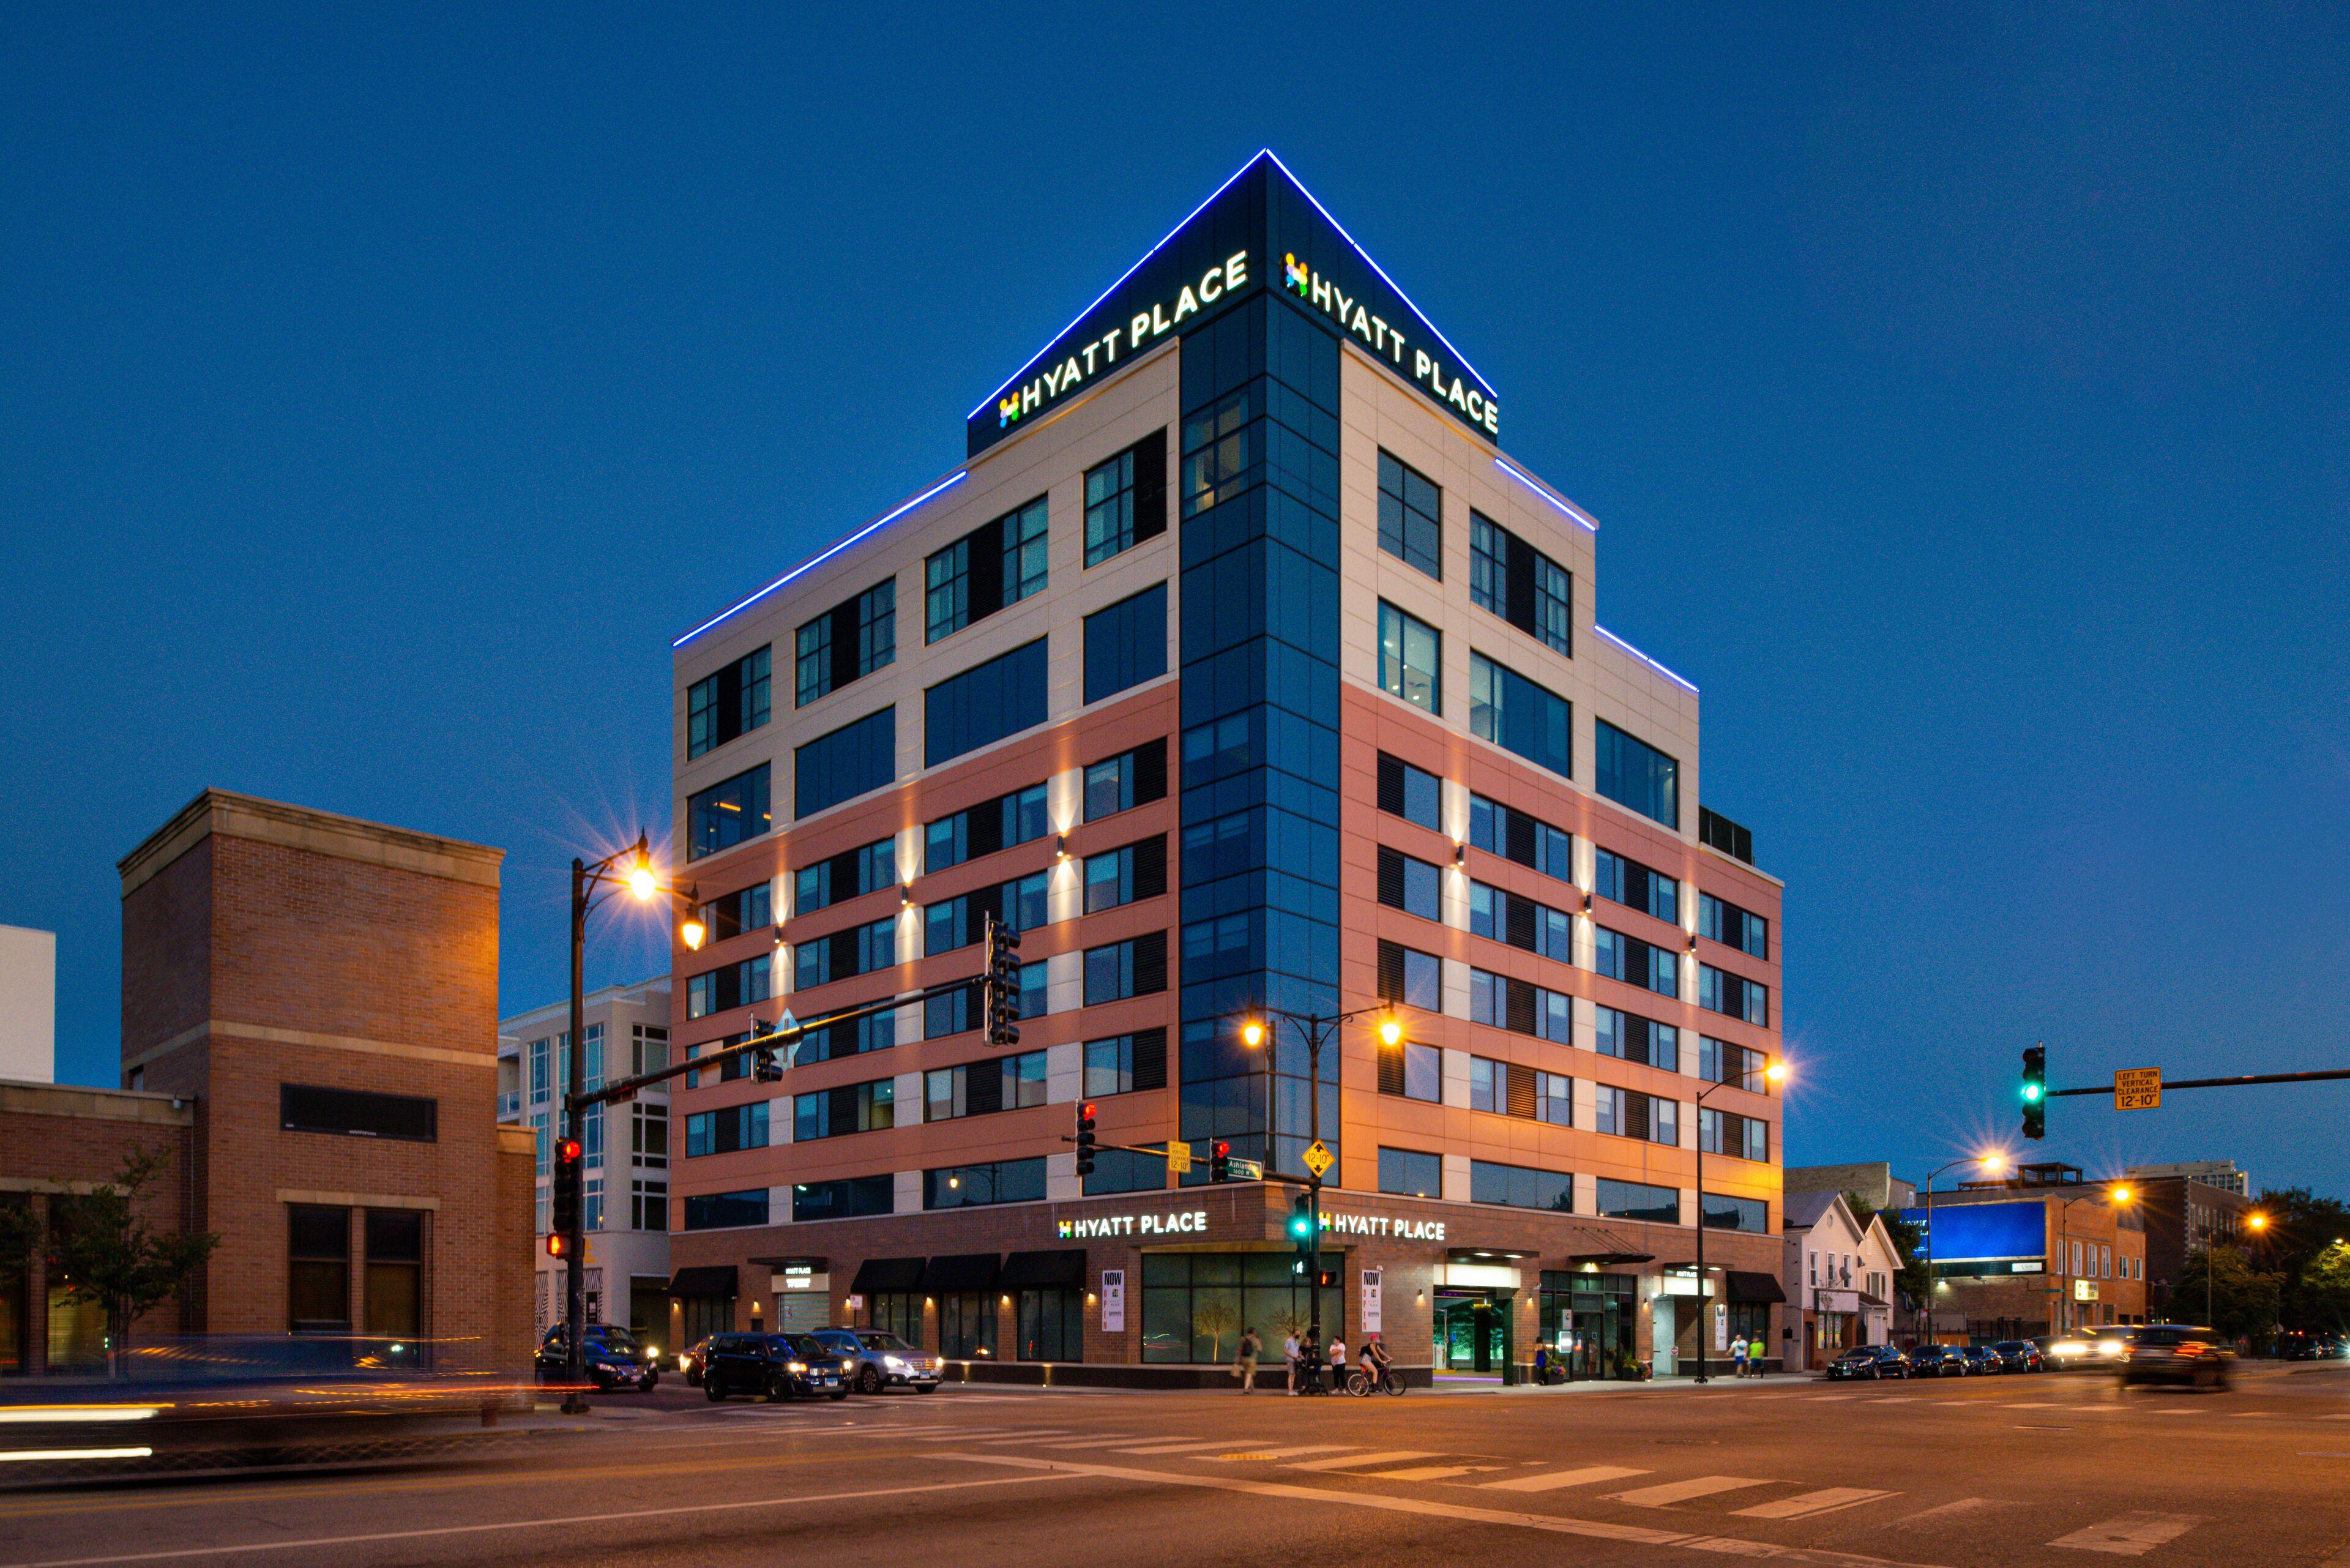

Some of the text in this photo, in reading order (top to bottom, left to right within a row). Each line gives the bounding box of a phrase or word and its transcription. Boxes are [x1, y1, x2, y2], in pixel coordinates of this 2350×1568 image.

[1023, 250, 1248, 414] HYATT PLACE
[1313, 272, 1498, 434] HYATT PLACE
[2118, 1086, 2158, 1096] CLEARANCE
[1229, 1160, 1251, 1170] Ashland
[1075, 1211, 1206, 1238] HYATT PLACE
[1335, 1214, 1445, 1241] HYATT PLACE
[1105, 1272, 1122, 1285] NOW
[1363, 1272, 1379, 1285] NOW
